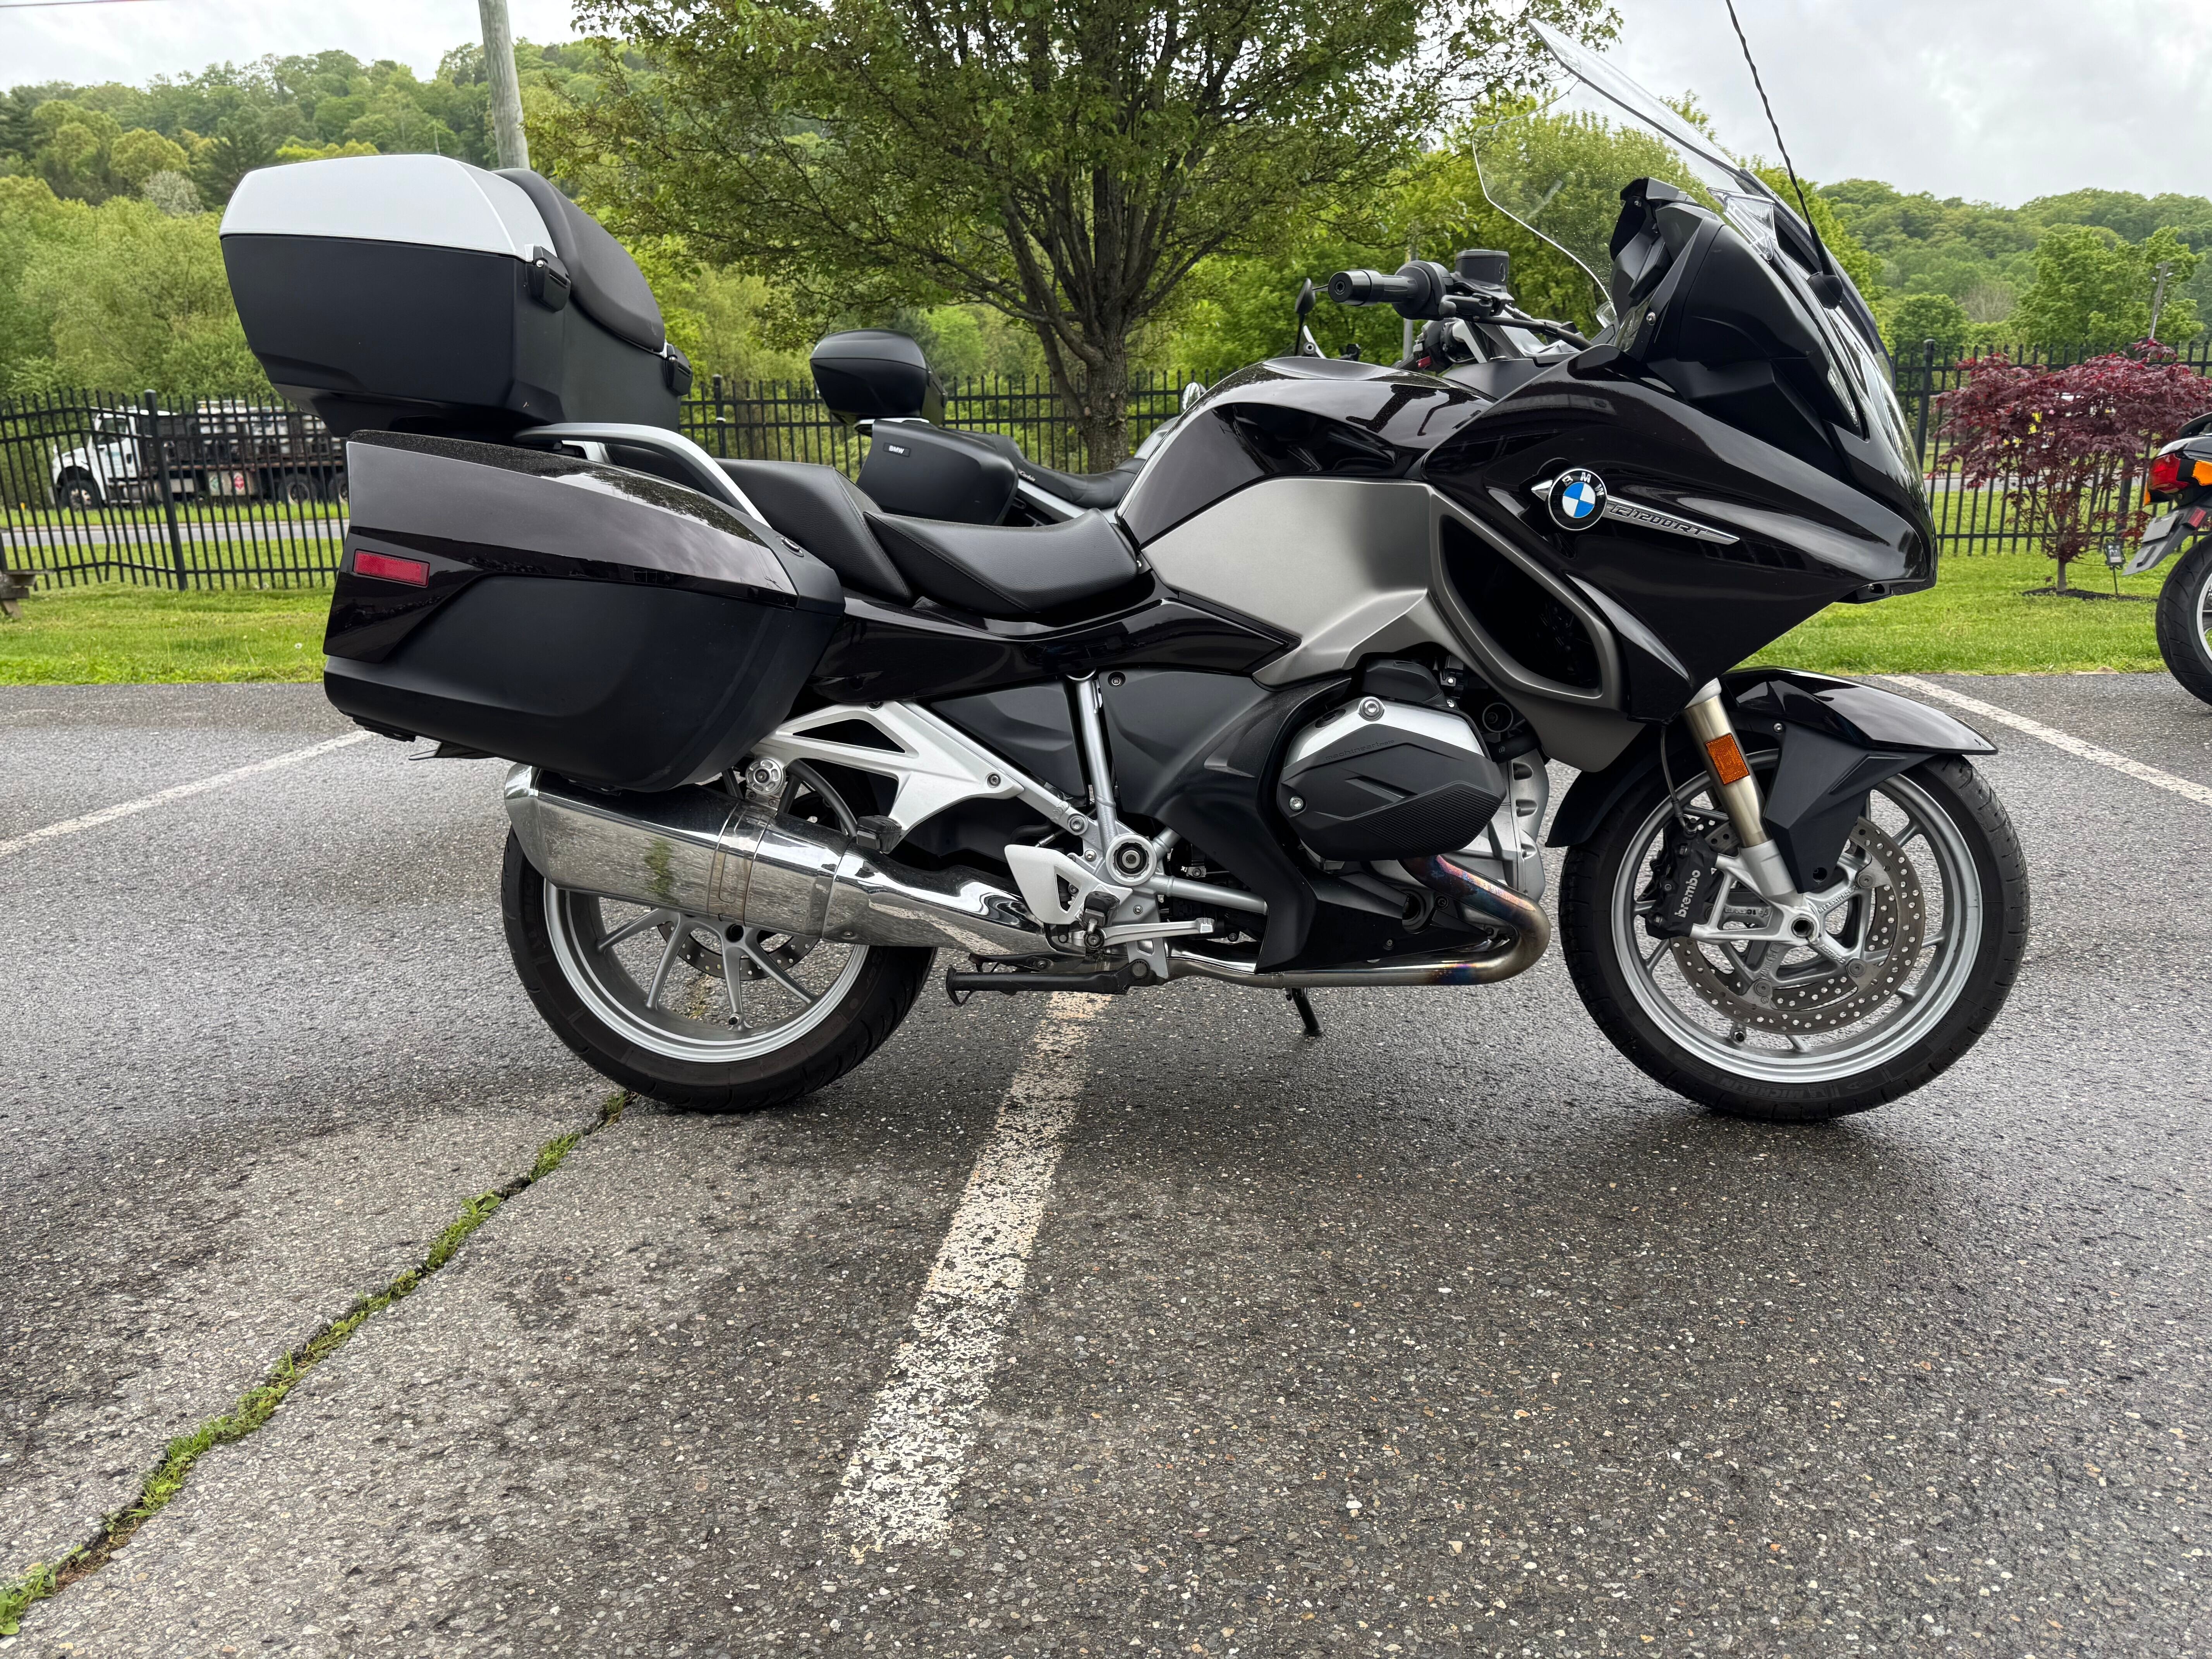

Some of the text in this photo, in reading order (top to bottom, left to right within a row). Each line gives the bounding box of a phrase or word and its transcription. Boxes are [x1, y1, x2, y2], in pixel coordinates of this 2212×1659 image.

[889, 445, 905, 454] BMW
[1562, 472, 1604, 496] BMW
[1674, 870, 1700, 918] brembo
[1719, 1077, 1804, 1098] MICHELIN
